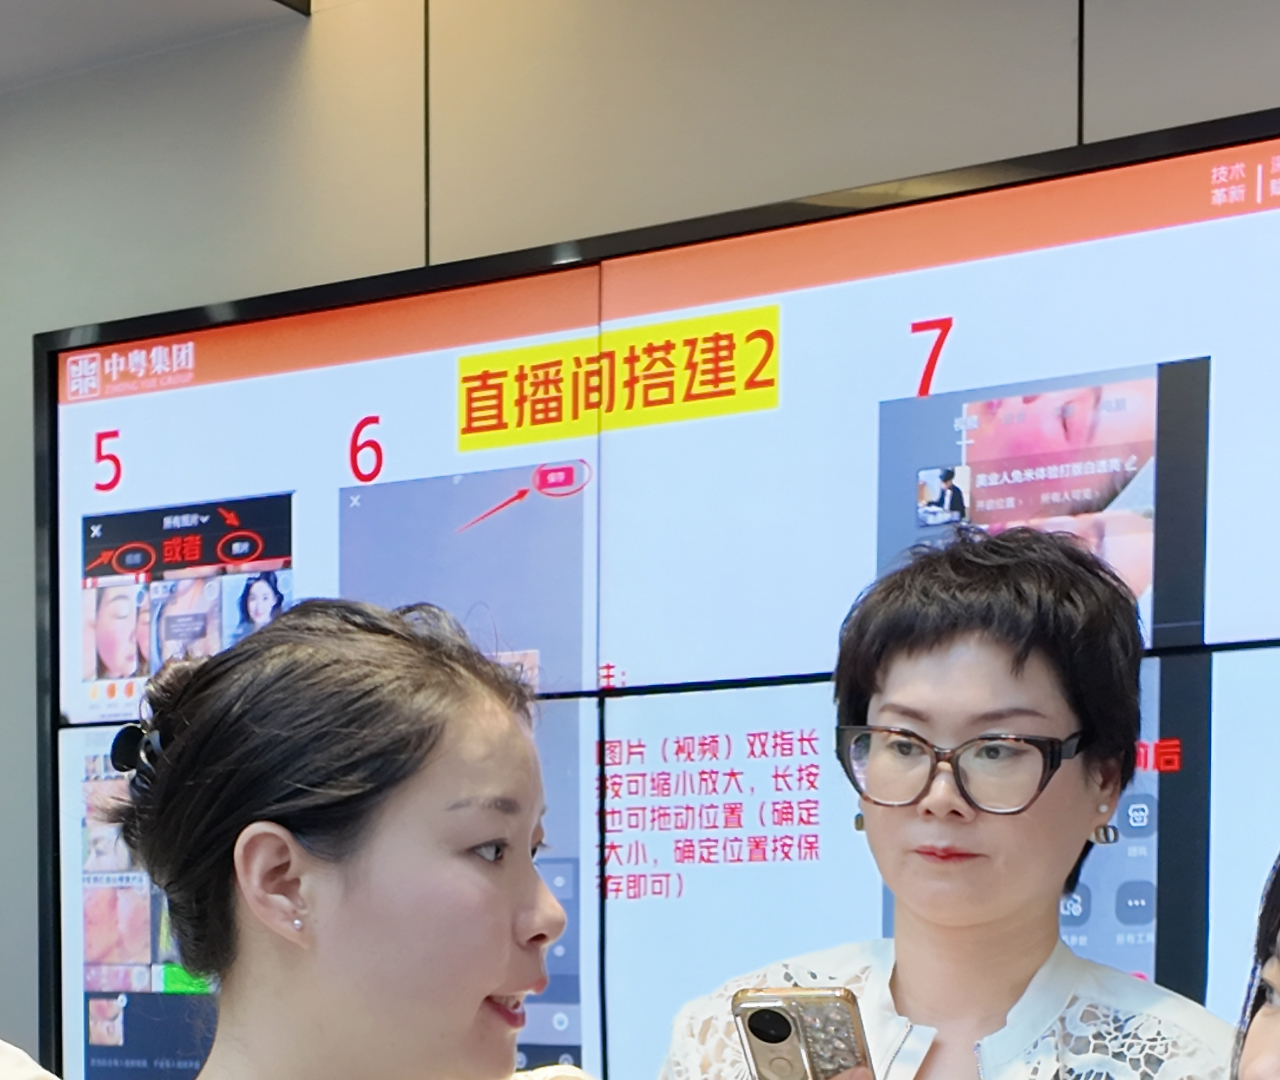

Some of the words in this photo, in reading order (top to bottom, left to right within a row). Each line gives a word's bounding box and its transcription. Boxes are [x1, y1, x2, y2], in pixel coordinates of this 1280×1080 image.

[1211, 162, 1246, 184] 技术
[1211, 184, 1246, 206] 革新
[104, 341, 194, 381] 中粤集团
[461, 329, 775, 435] 直播间搭建2
[910, 317, 953, 396] 7
[94, 429, 122, 491] 5
[349, 415, 383, 482] 6
[162, 534, 202, 563] 或者
